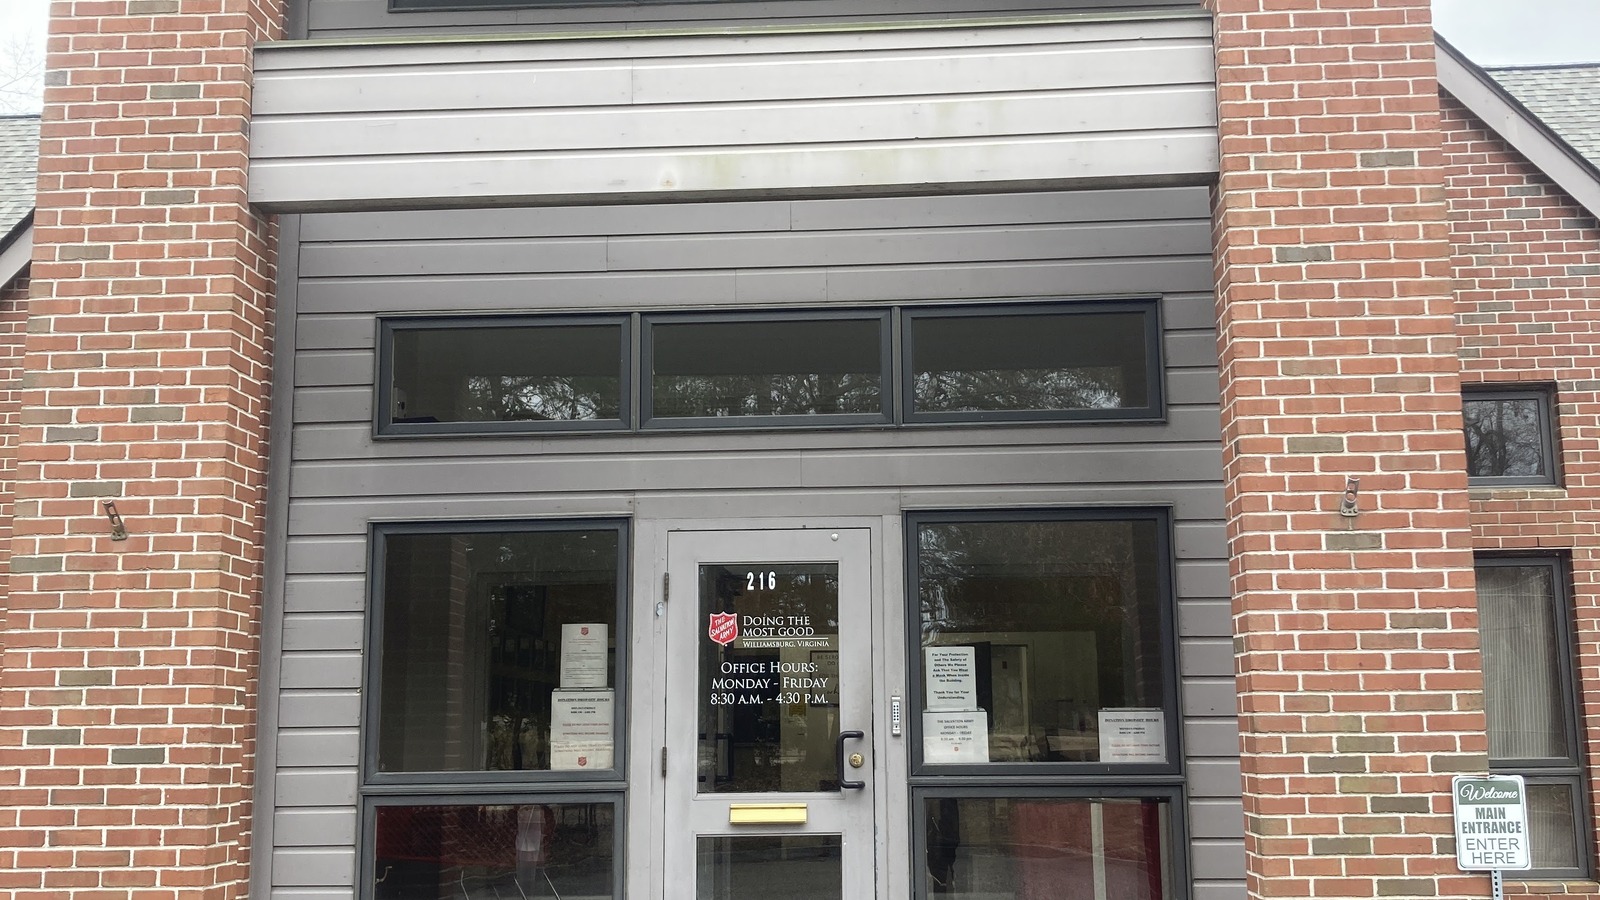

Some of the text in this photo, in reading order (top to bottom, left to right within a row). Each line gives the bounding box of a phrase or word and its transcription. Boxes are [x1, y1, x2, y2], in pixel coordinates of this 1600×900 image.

[746, 571, 776, 591] 216
[715, 616, 725, 626] THE
[743, 615, 810, 626] DOING THE
[711, 618, 735, 636] SALVATION
[720, 626, 733, 640] ARMY
[743, 626, 814, 637] MOST GOOD
[721, 661, 818, 674] OFFICE HOURS:
[712, 678, 770, 689] MONDAY
[783, 677, 828, 688] FRIDAY
[710, 693, 735, 705] 8:30
[738, 694, 764, 704] A.M.
[775, 692, 800, 704] 4:30
[804, 693, 829, 704] P.M.
[1460, 784, 1518, 801] Welcome
[1475, 807, 1506, 819] MAIN
[1462, 821, 1522, 834] ENTRANCE
[1466, 838, 1520, 850] ENTER
[1472, 852, 1516, 864] HERE
